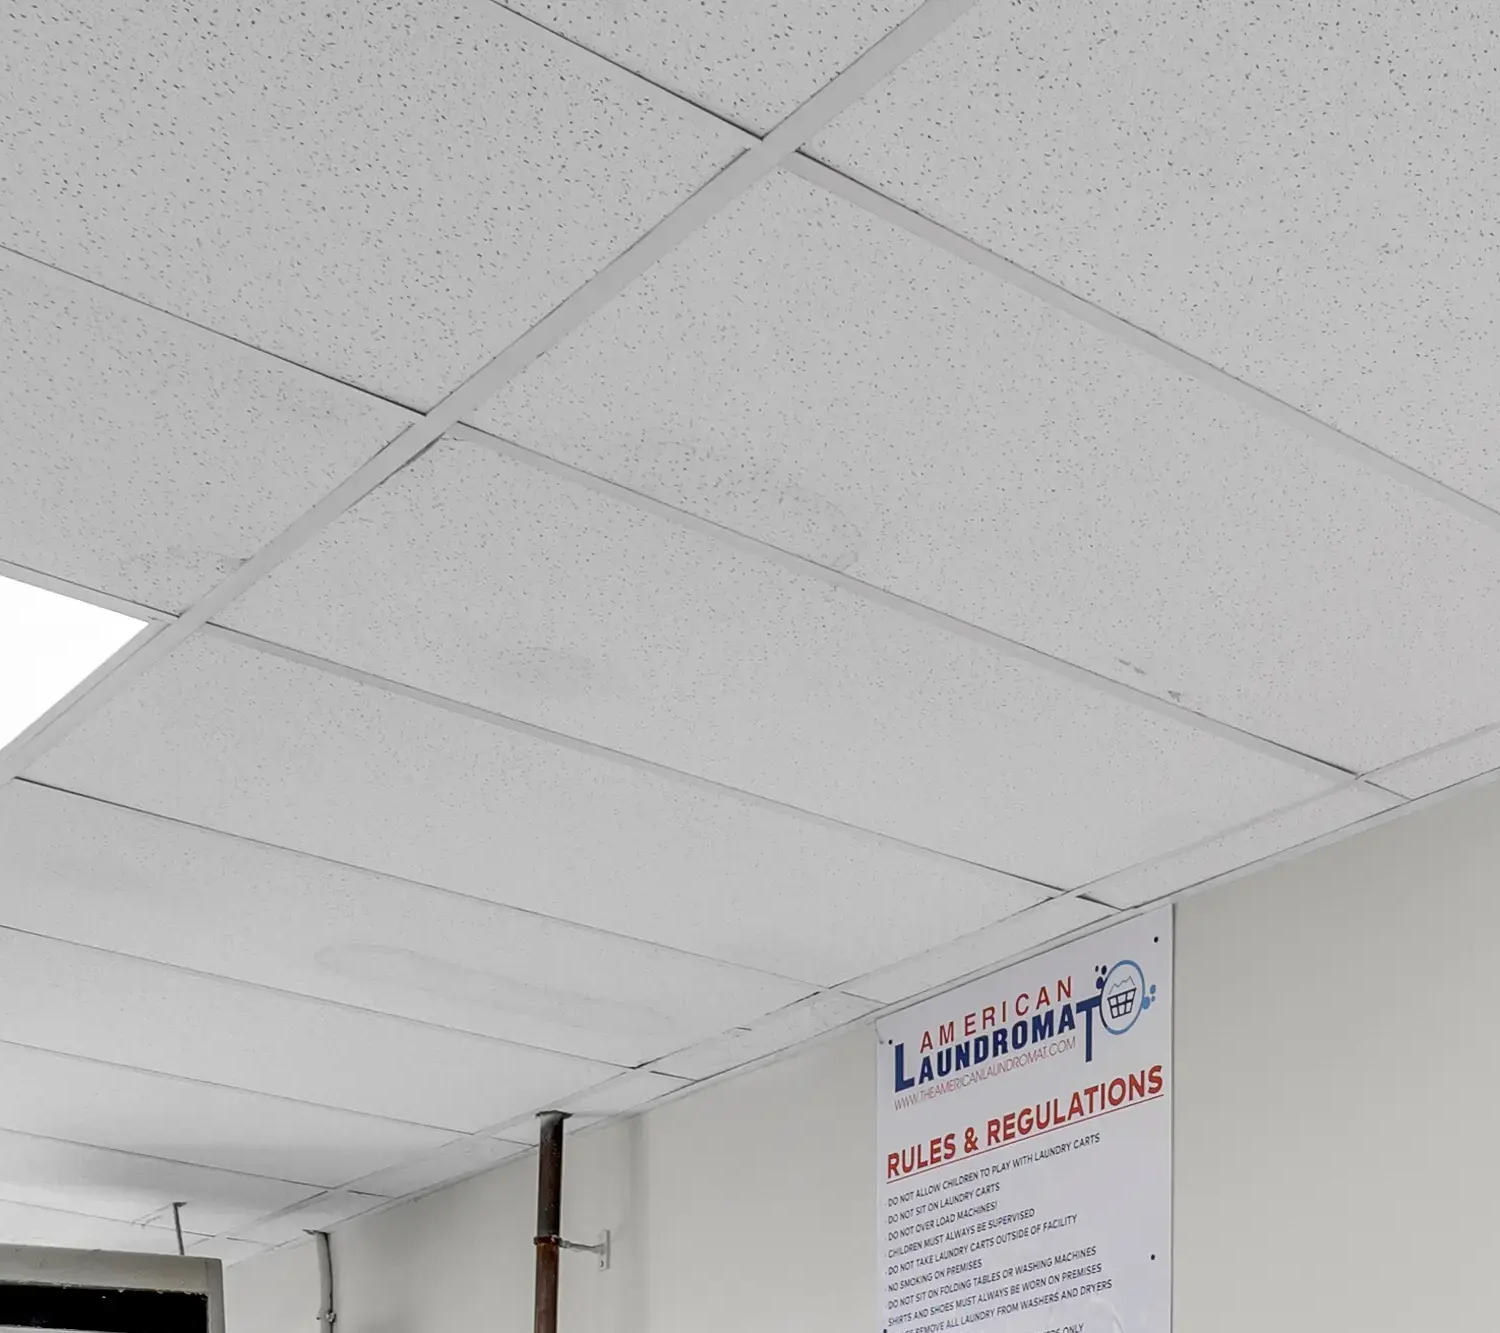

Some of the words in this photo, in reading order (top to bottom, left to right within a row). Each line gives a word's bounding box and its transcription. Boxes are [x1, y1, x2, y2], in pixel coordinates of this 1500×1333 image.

[894, 994, 1102, 1093] LAUNDROMAT
[920, 977, 1074, 1053] AMERICAN
[887, 1134, 955, 1179] RULES
[965, 1127, 978, 1153] &
[987, 1065, 1163, 1147] REGULATIONS
[888, 1194, 898, 1207] DO
[899, 1190, 914, 1203] NOT
[915, 1181, 941, 1199] ALLOW
[942, 1169, 978, 1190] CHILDREN
[980, 1166, 990, 1179] TO
[991, 1159, 1010, 1175] PLAY
[1012, 1152, 1033, 1169] WITH
[1034, 1141, 1071, 1162] LAUNDRY
[1073, 1132, 1100, 1150] CARTS
[888, 1239, 922, 1258] CHILDREN
[923, 1233, 943, 1248] MUST
[945, 1224, 975, 1242] ALWAYS
[976, 1220, 986, 1233] BE
[987, 1206, 1034, 1230] SUPERVISED
[888, 1311, 912, 1326] SHIRTS
[913, 1307, 928, 1320] AND
[930, 1300, 954, 1316] SHOES
[955, 1294, 976, 1309] MUST
[977, 1286, 1008, 1304] ALWAYS
[1009, 1283, 1020, 1295] BE
[1021, 1276, 1046, 1292] WORN
[1047, 1272, 1060, 1286] ON
[1061, 1262, 1101, 1282] PREMISES
